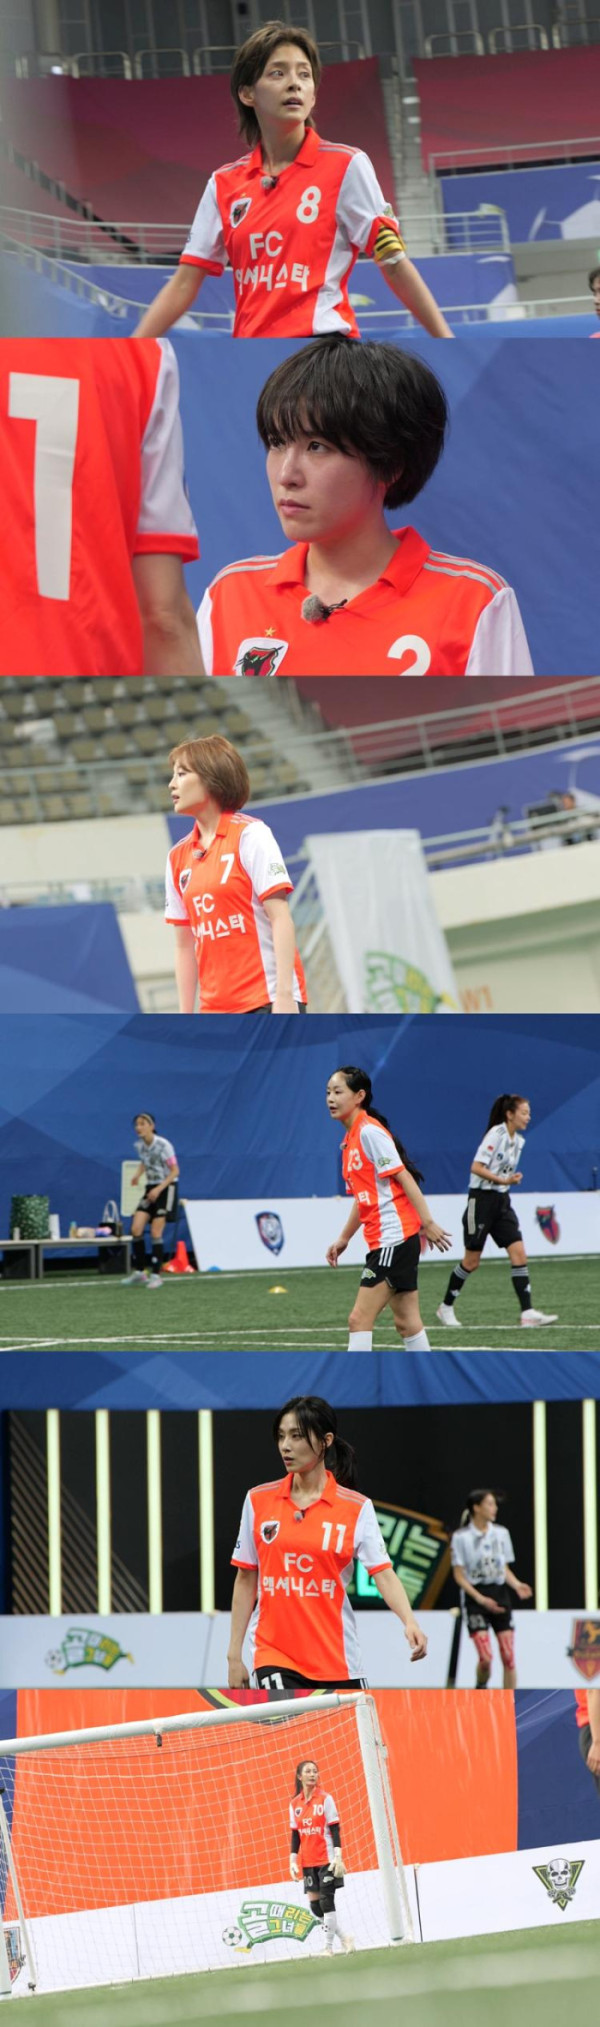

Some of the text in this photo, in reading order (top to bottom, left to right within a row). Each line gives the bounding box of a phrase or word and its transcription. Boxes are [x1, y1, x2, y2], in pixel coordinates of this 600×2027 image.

[296, 186, 321, 224] 8
[249, 231, 284, 260] FC
[8, 372, 80, 602] 1
[387, 634, 432, 676] 2
[219, 853, 235, 885] 7
[192, 893, 215, 917] FC
[321, 1521, 347, 1554] 11
[284, 1552, 314, 1573] FC
[261, 1672, 285, 1689] 11
[302, 1817, 313, 1827] FC
[312, 1804, 324, 1816] 10
